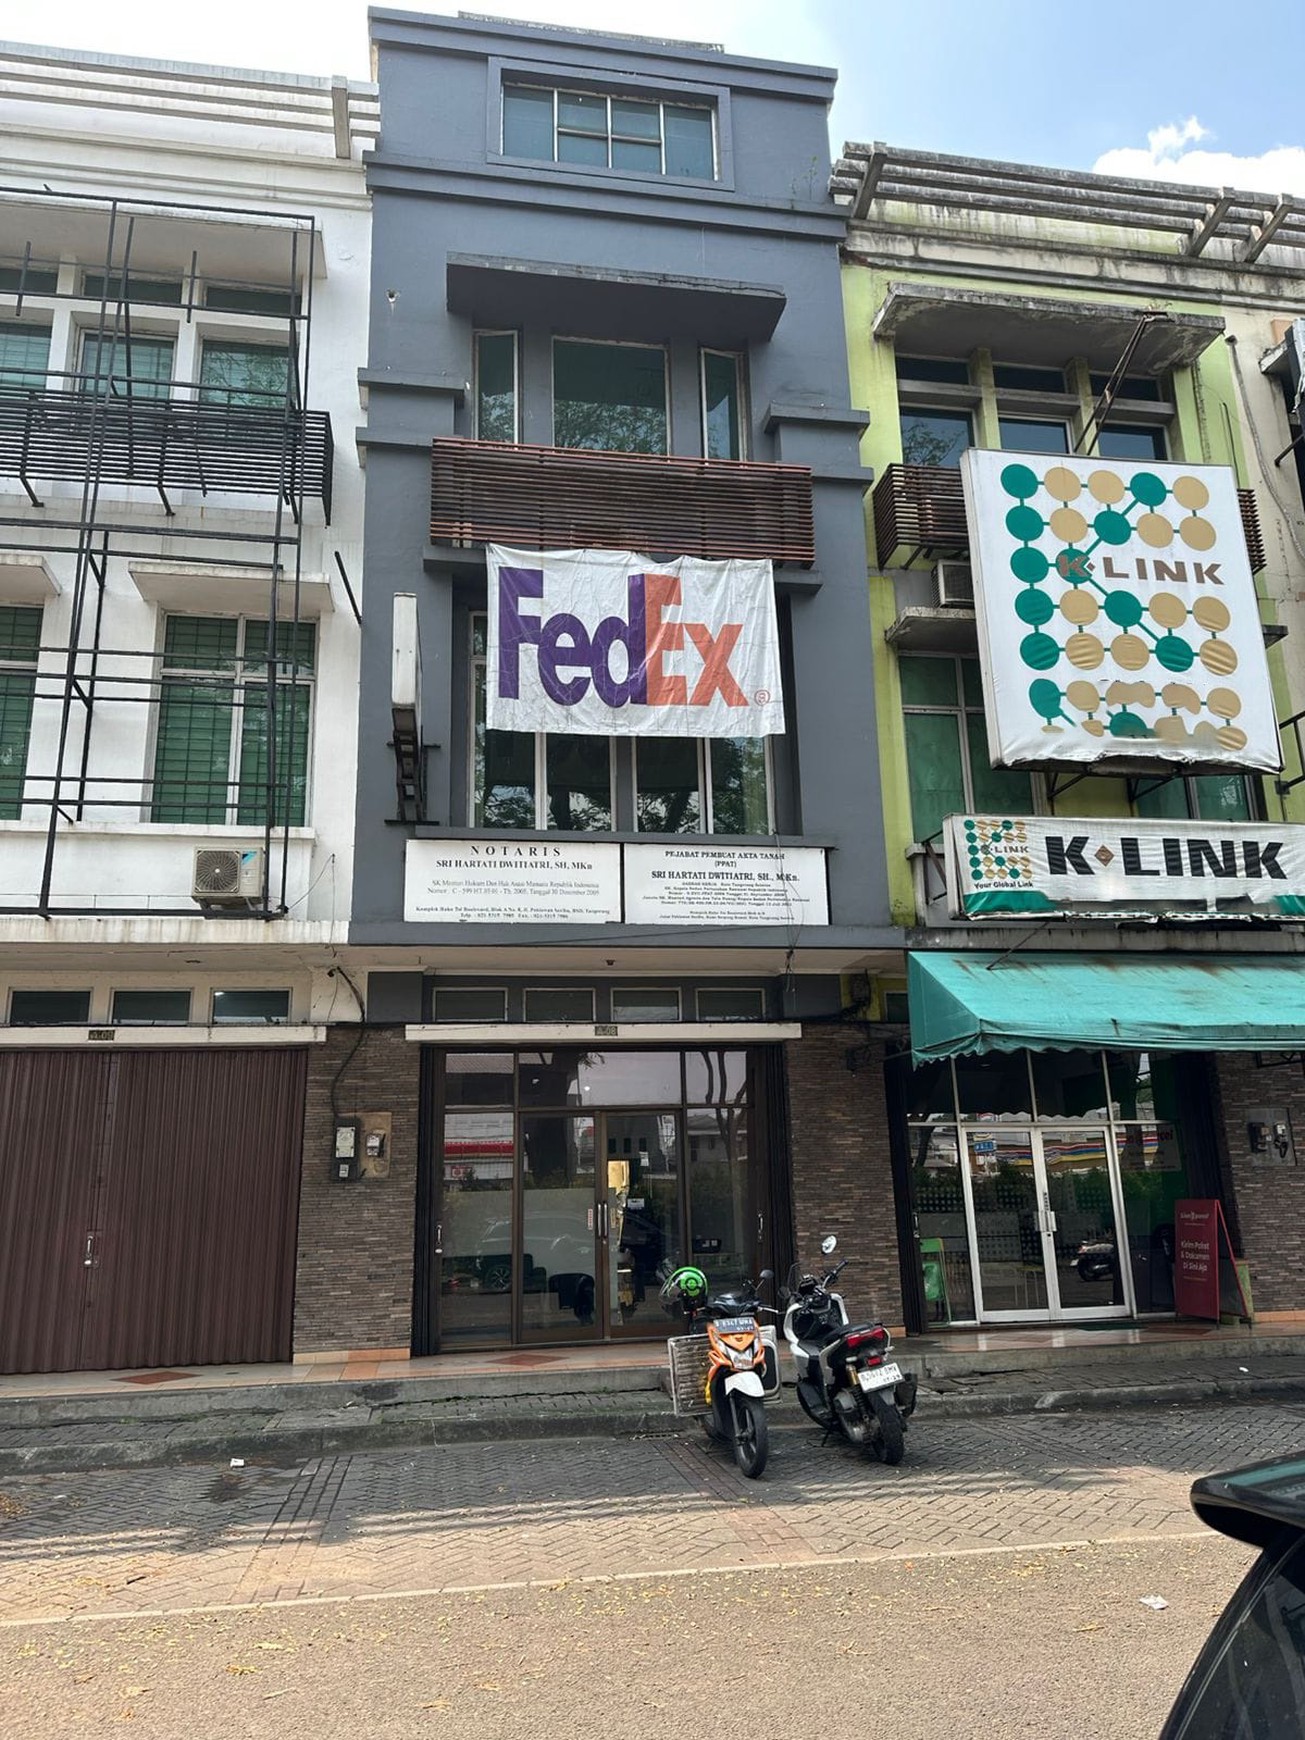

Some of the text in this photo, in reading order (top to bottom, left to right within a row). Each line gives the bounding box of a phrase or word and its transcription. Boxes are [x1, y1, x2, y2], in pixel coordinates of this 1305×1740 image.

[498, 565, 750, 708] FedEx
[471, 845, 561, 857] NOTARIS
[701, 851, 736, 859] PEMBUAT
[436, 860, 452, 868] SRI
[455, 860, 497, 868] HARTATI
[715, 860, 737, 868] (PPAT)
[651, 870, 666, 879] SRI
[668, 871, 706, 880] HARTATI
[1017, 880, 1034, 888] Link
